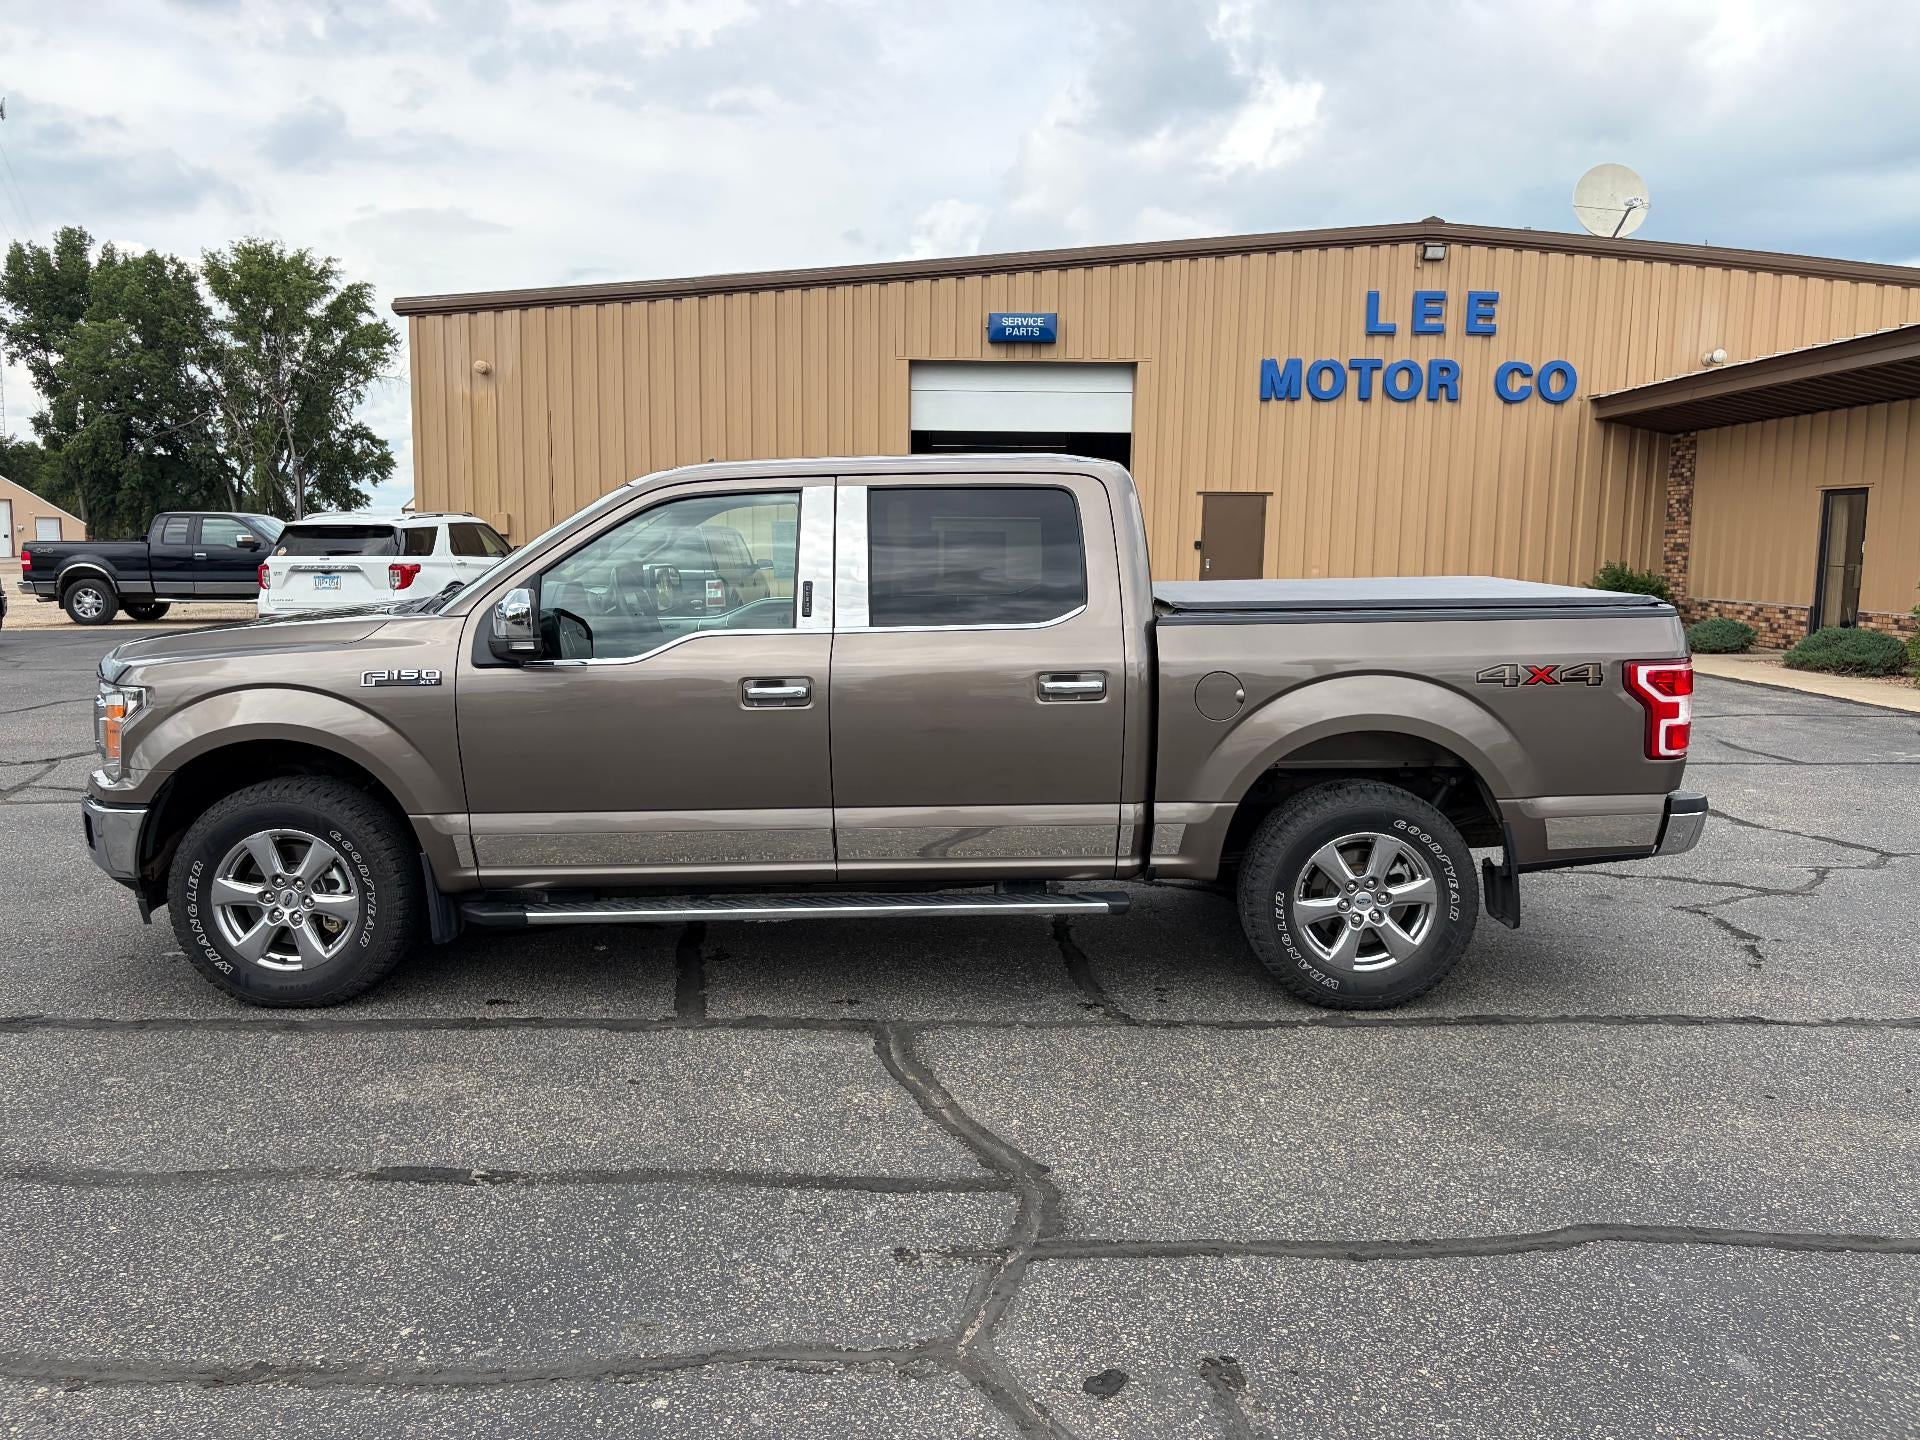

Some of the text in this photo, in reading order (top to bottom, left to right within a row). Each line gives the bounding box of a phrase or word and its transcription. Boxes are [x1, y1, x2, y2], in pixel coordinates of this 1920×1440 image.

[1001, 317, 1045, 326] SERVICE
[1005, 327, 1040, 336] PARTS
[1366, 290, 1499, 336] LEE
[1260, 358, 1578, 404] MOTOR CO
[329, 830, 377, 948] GOODYEAR
[1394, 819, 1461, 922] GOODYEAR
[188, 860, 234, 975] WRANGLER
[1275, 891, 1340, 990] WRANGLER
